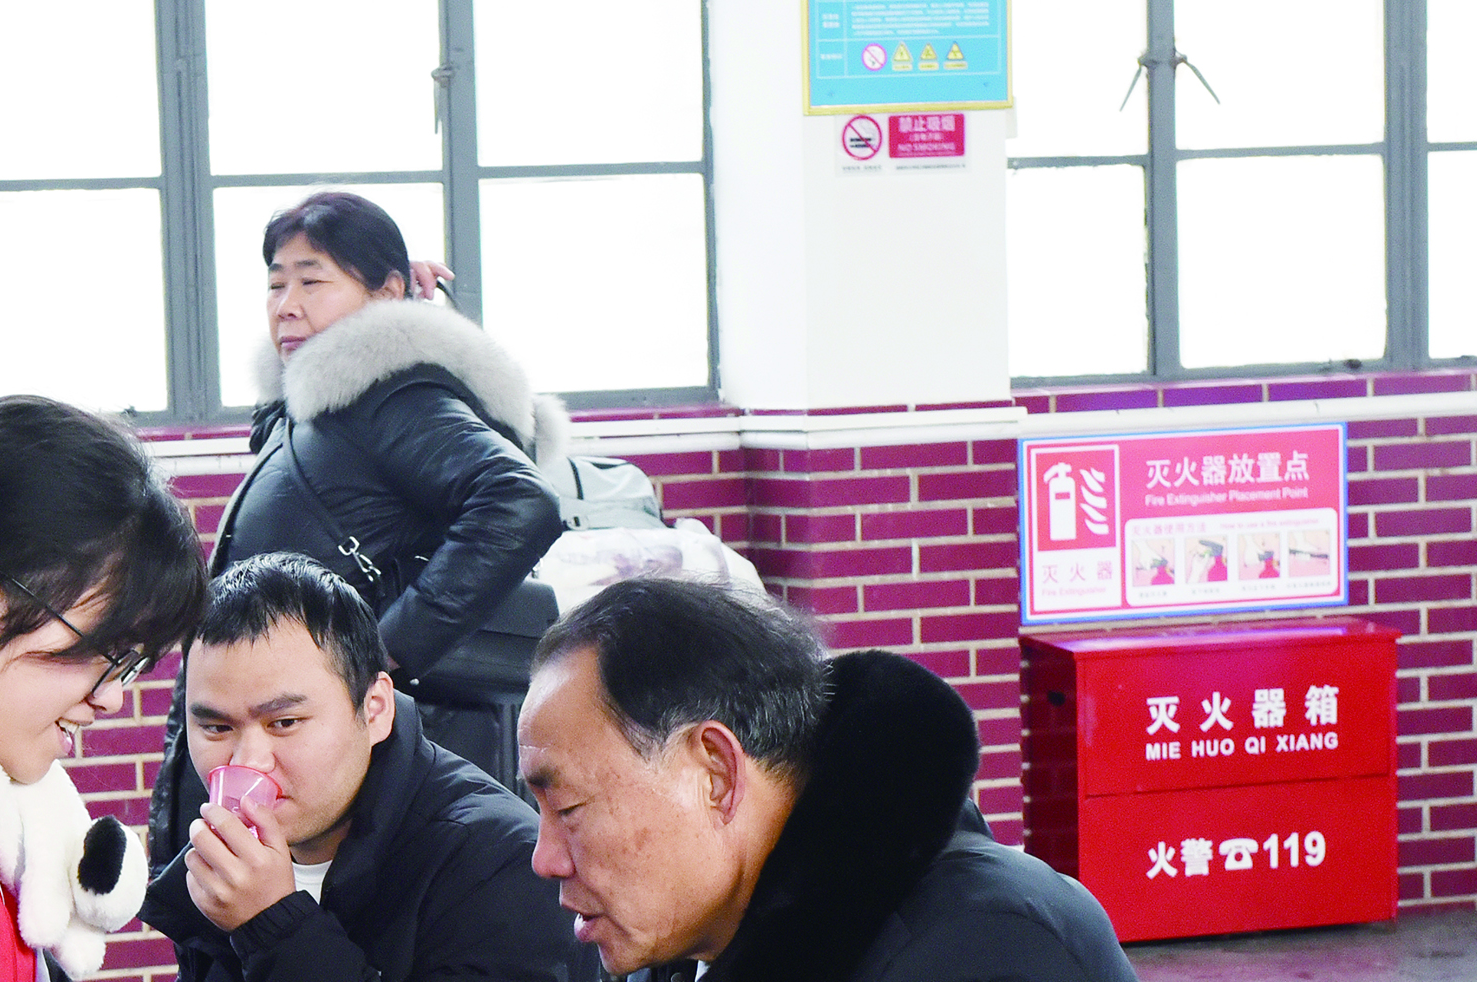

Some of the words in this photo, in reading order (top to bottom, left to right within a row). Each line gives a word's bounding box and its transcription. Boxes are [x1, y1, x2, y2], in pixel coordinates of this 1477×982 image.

[1145, 450, 1310, 489] 灭火器放置点
[1145, 494, 1165, 507] Fire
[1167, 491, 1228, 507] Extinguisher
[1228, 488, 1281, 502] Placement
[1282, 486, 1309, 500] Point
[1042, 561, 1112, 584] 灭火器
[1146, 684, 1339, 735] 灭火器箱
[1145, 741, 1181, 761] MIE
[1191, 738, 1235, 758] HUO
[1244, 736, 1267, 755] QI
[1276, 731, 1339, 753] XIANG
